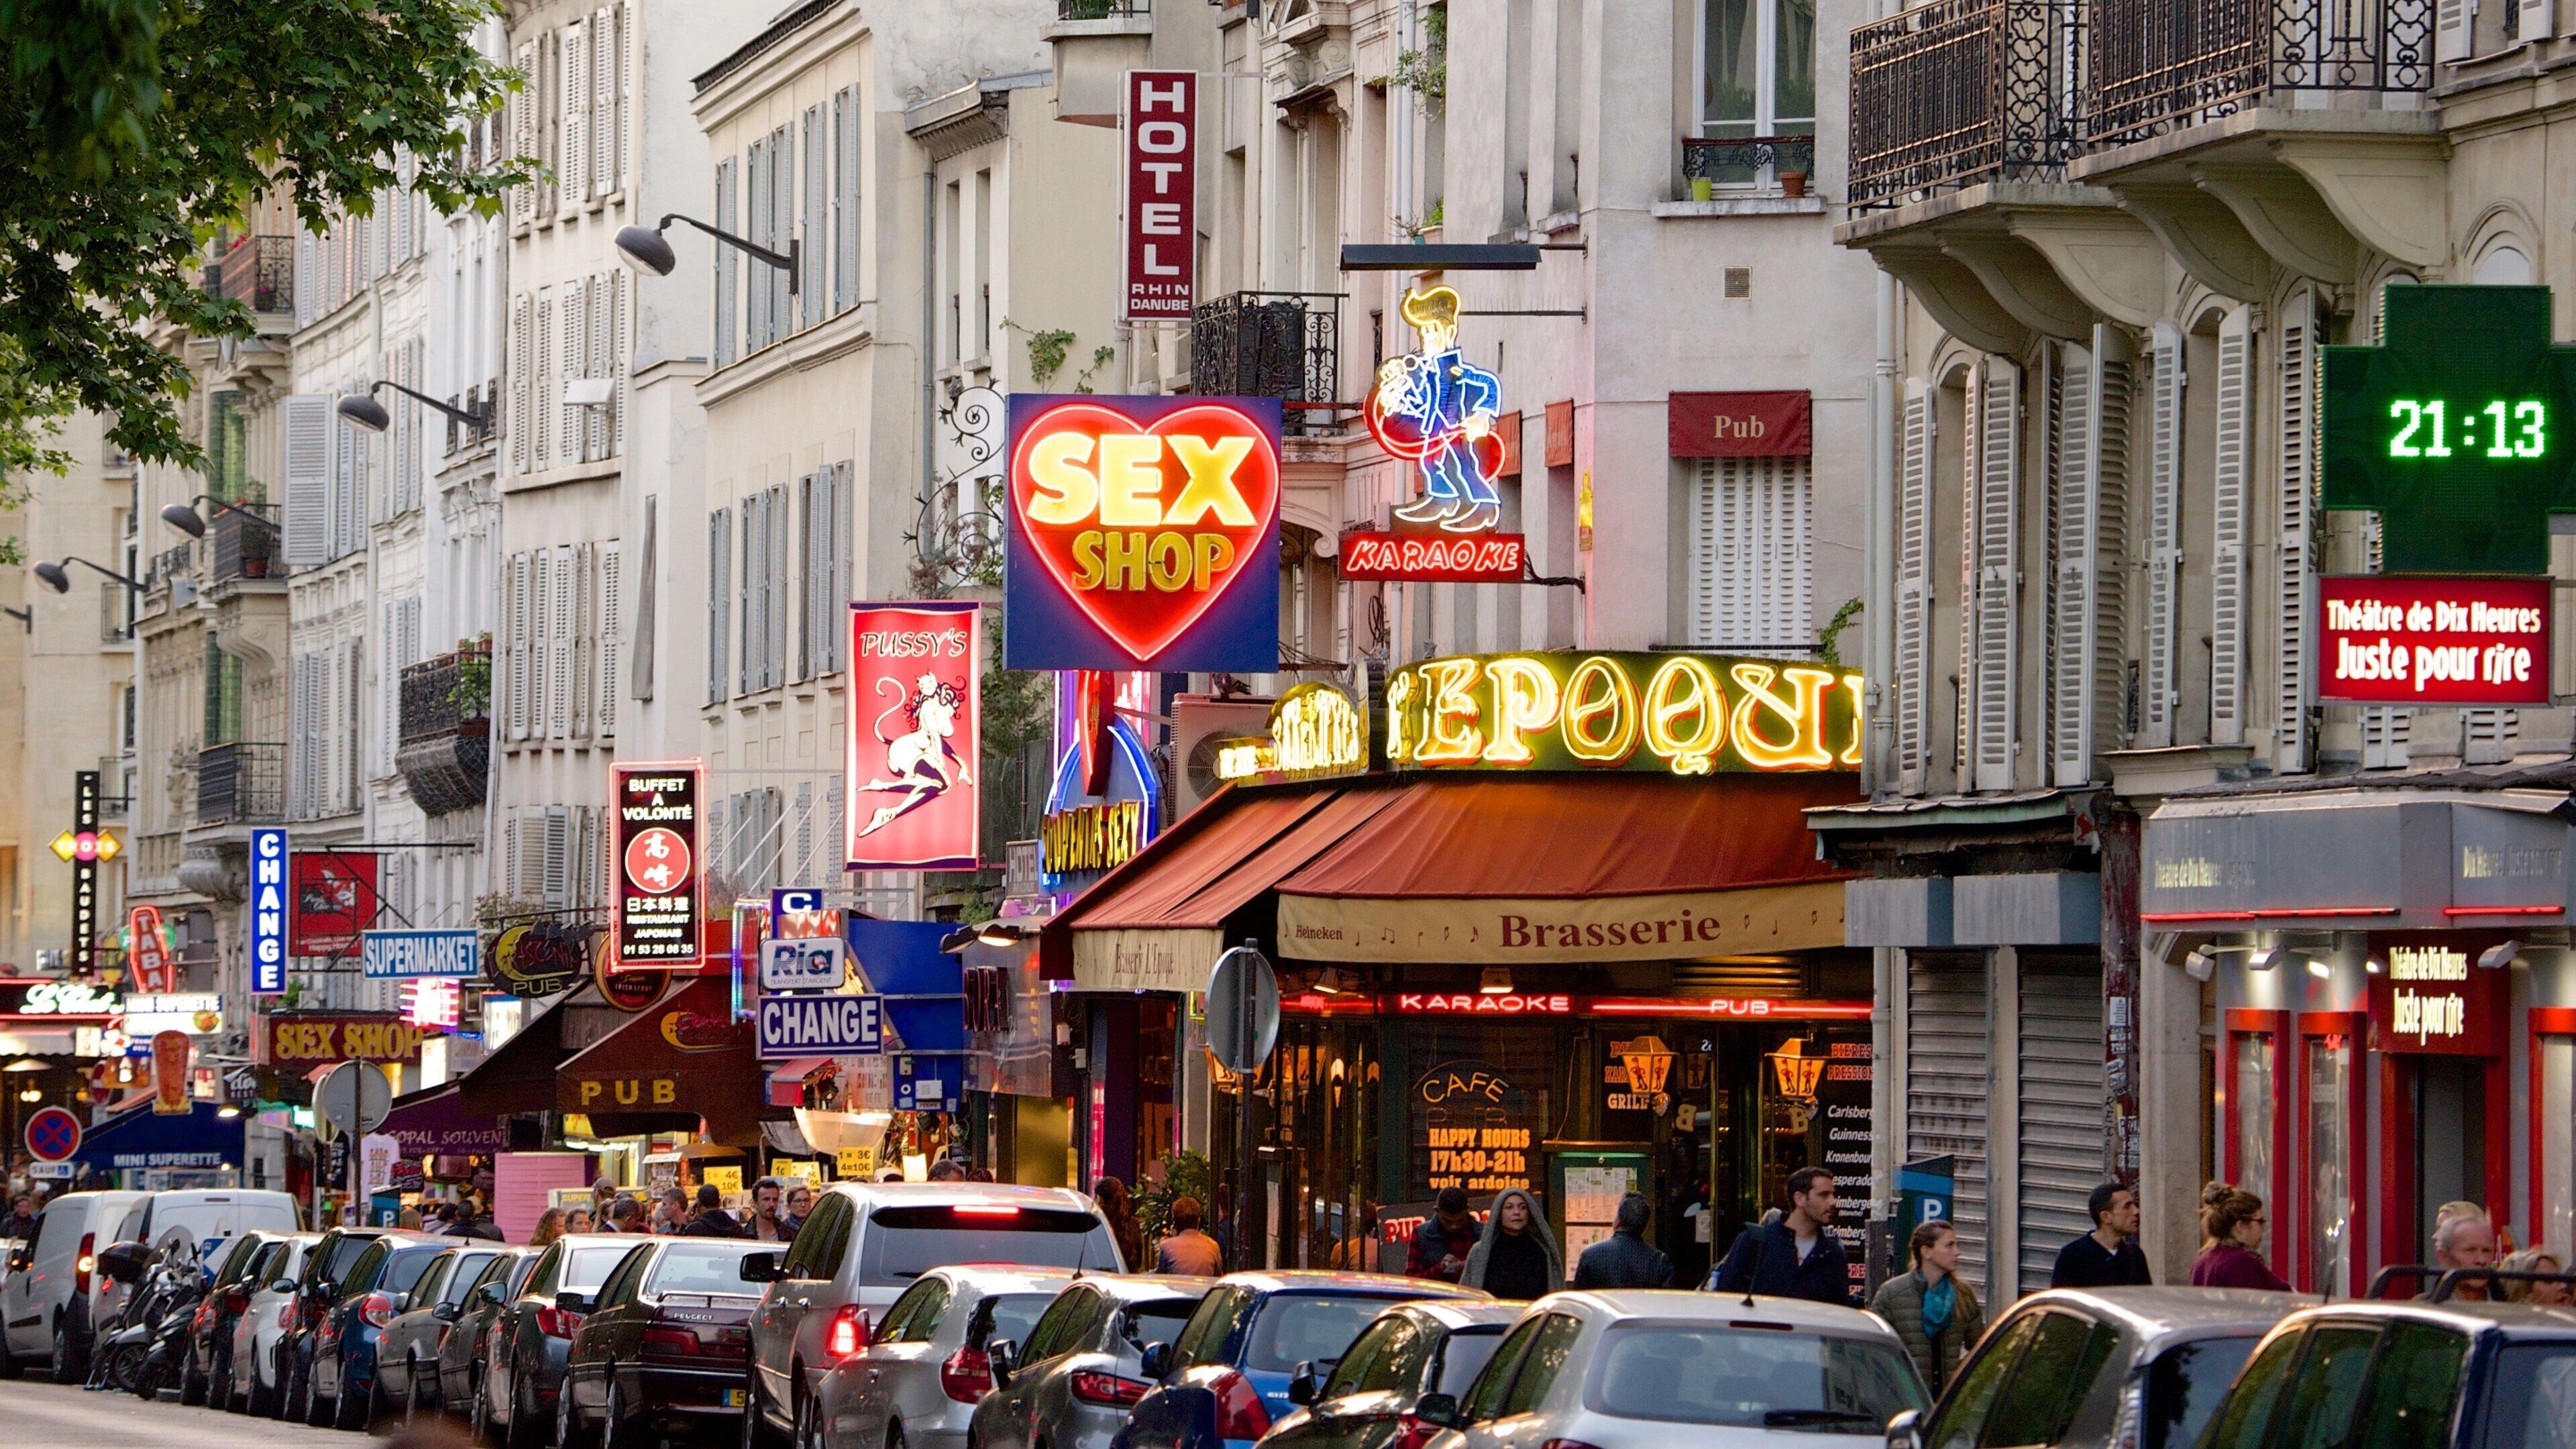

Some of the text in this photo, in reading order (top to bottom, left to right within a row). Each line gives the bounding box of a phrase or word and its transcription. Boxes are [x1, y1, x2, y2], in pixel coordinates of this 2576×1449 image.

[1138, 81, 1186, 275] HOTEL
[1132, 284, 1189, 295] RHIN
[1131, 299, 1189, 311] DANUBE
[1713, 415, 1764, 438] Pub
[2390, 400, 2544, 458] 21:13
[1026, 431, 1258, 526] SEX
[1071, 531, 1234, 592] SHOP
[1346, 539, 1519, 572] KARAOKE
[2326, 599, 2541, 633] Théâtre de Dix Heures
[860, 627, 968, 658] PUSSY'S
[2336, 637, 2531, 692] Juste pour rire
[629, 778, 686, 792] BUFFET
[83, 786, 93, 825] LES
[651, 793, 664, 806] A
[623, 804, 692, 820] VOLONTÉ
[57, 841, 116, 853] TROIS
[78, 867, 92, 963] BAUDETS
[258, 833, 280, 989] CHANGE
[627, 897, 689, 912] 日本料理
[627, 914, 690, 925] RESTAURANT
[1499, 910, 1721, 948] Brasserie
[634, 928, 683, 939] JAPONAIS
[1295, 924, 1342, 942] Heineken
[137, 916, 164, 994] TABA
[365, 936, 476, 974] SUPERMARKET
[623, 945, 635, 955] 01
[638, 945, 651, 955] 53
[680, 944, 694, 955] 35
[771, 943, 834, 976] Ria
[2390, 947, 2467, 981] Théâtre de Dix Heures
[513, 978, 563, 995] PUB
[1401, 993, 1570, 1012] KARAOKE
[1709, 999, 1770, 1015] PUB
[763, 1000, 878, 1045] CHANGE
[2393, 987, 2464, 1046] Juste pour rire
[276, 1022, 423, 1059] SEX SHOP
[1831, 1043, 1872, 1058] BIERES
[581, 1079, 676, 1106] PUB
[1422, 1072, 1509, 1104] CAFE
[1429, 1128, 1530, 1148] HAPPY HOURS
[1829, 1128, 1873, 1141] Guinness
[114, 1152, 221, 1167] MINI SUPERETTE
[857, 1150, 871, 1160] 3€
[1430, 1150, 1525, 1173] 17h30-21h
[725, 1171, 738, 1179] 4€
[1429, 1175, 1529, 1189] voir ardoise
[383, 1210, 394, 1227] P
[1923, 1199, 1943, 1222] P
[674, 1313, 714, 1321] PEUGEOT
